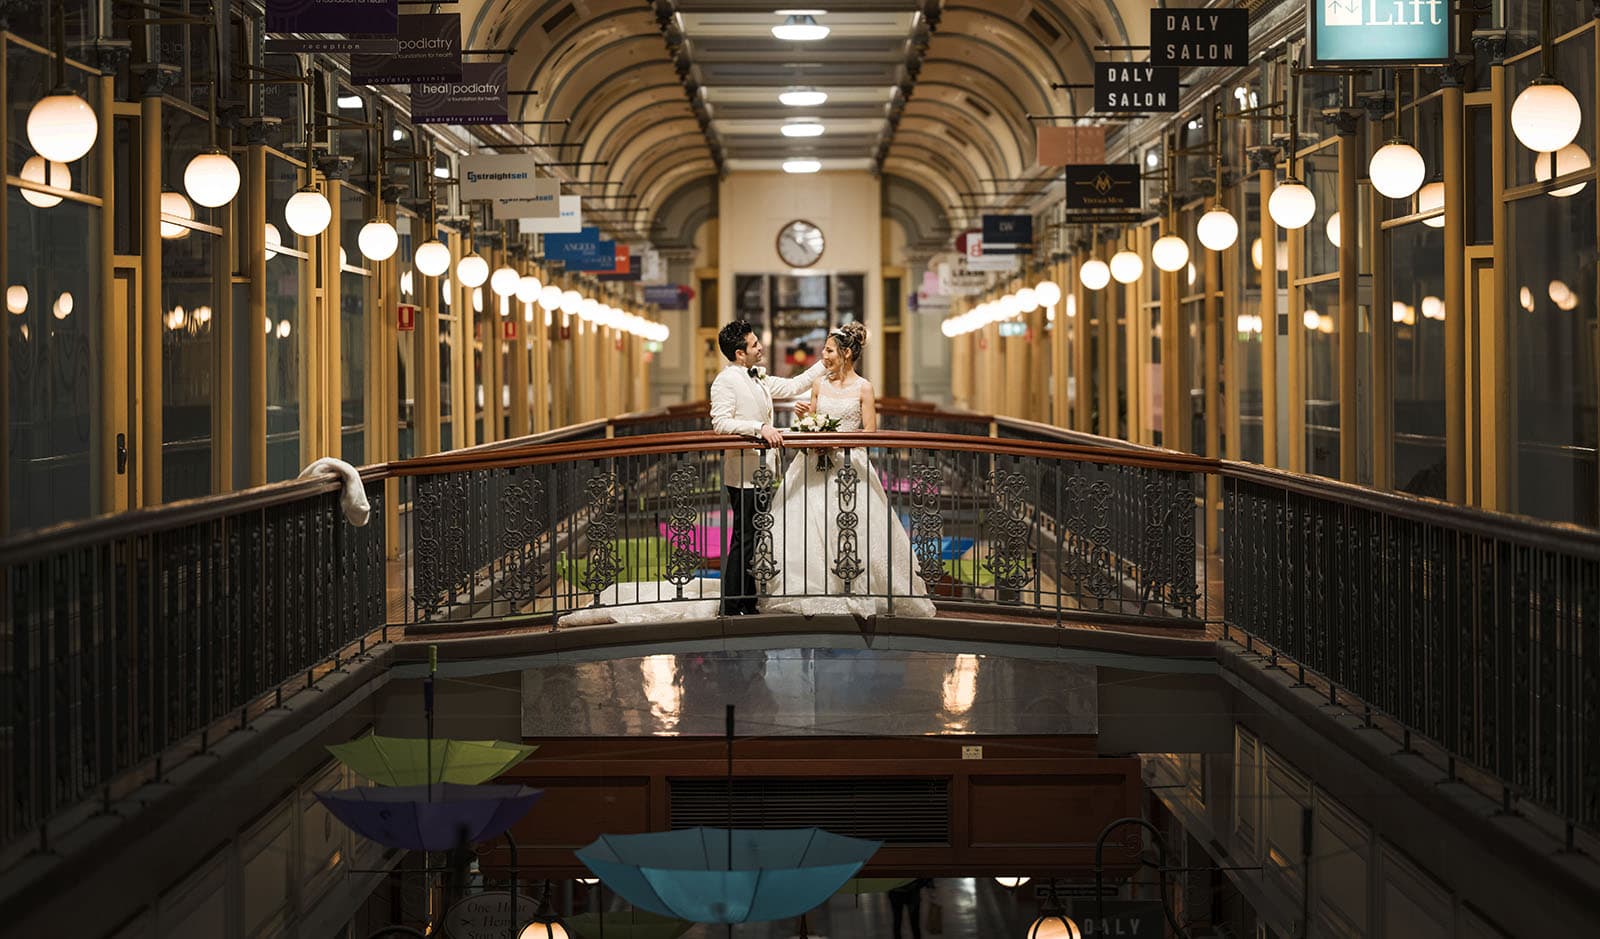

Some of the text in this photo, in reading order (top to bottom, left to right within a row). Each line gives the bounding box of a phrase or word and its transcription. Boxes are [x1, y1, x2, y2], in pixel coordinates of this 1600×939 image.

[1365, 0, 1442, 26] Lift
[1167, 15, 1218, 31] DALY
[398, 38, 453, 51] podiatry
[1166, 44, 1233, 60] SALON
[1108, 68, 1153, 82] DALY
[1108, 92, 1166, 106] SALON
[477, 172, 528, 181] straightsell
[467, 903, 490, 913] One
[1084, 918, 1141, 935] DALY
